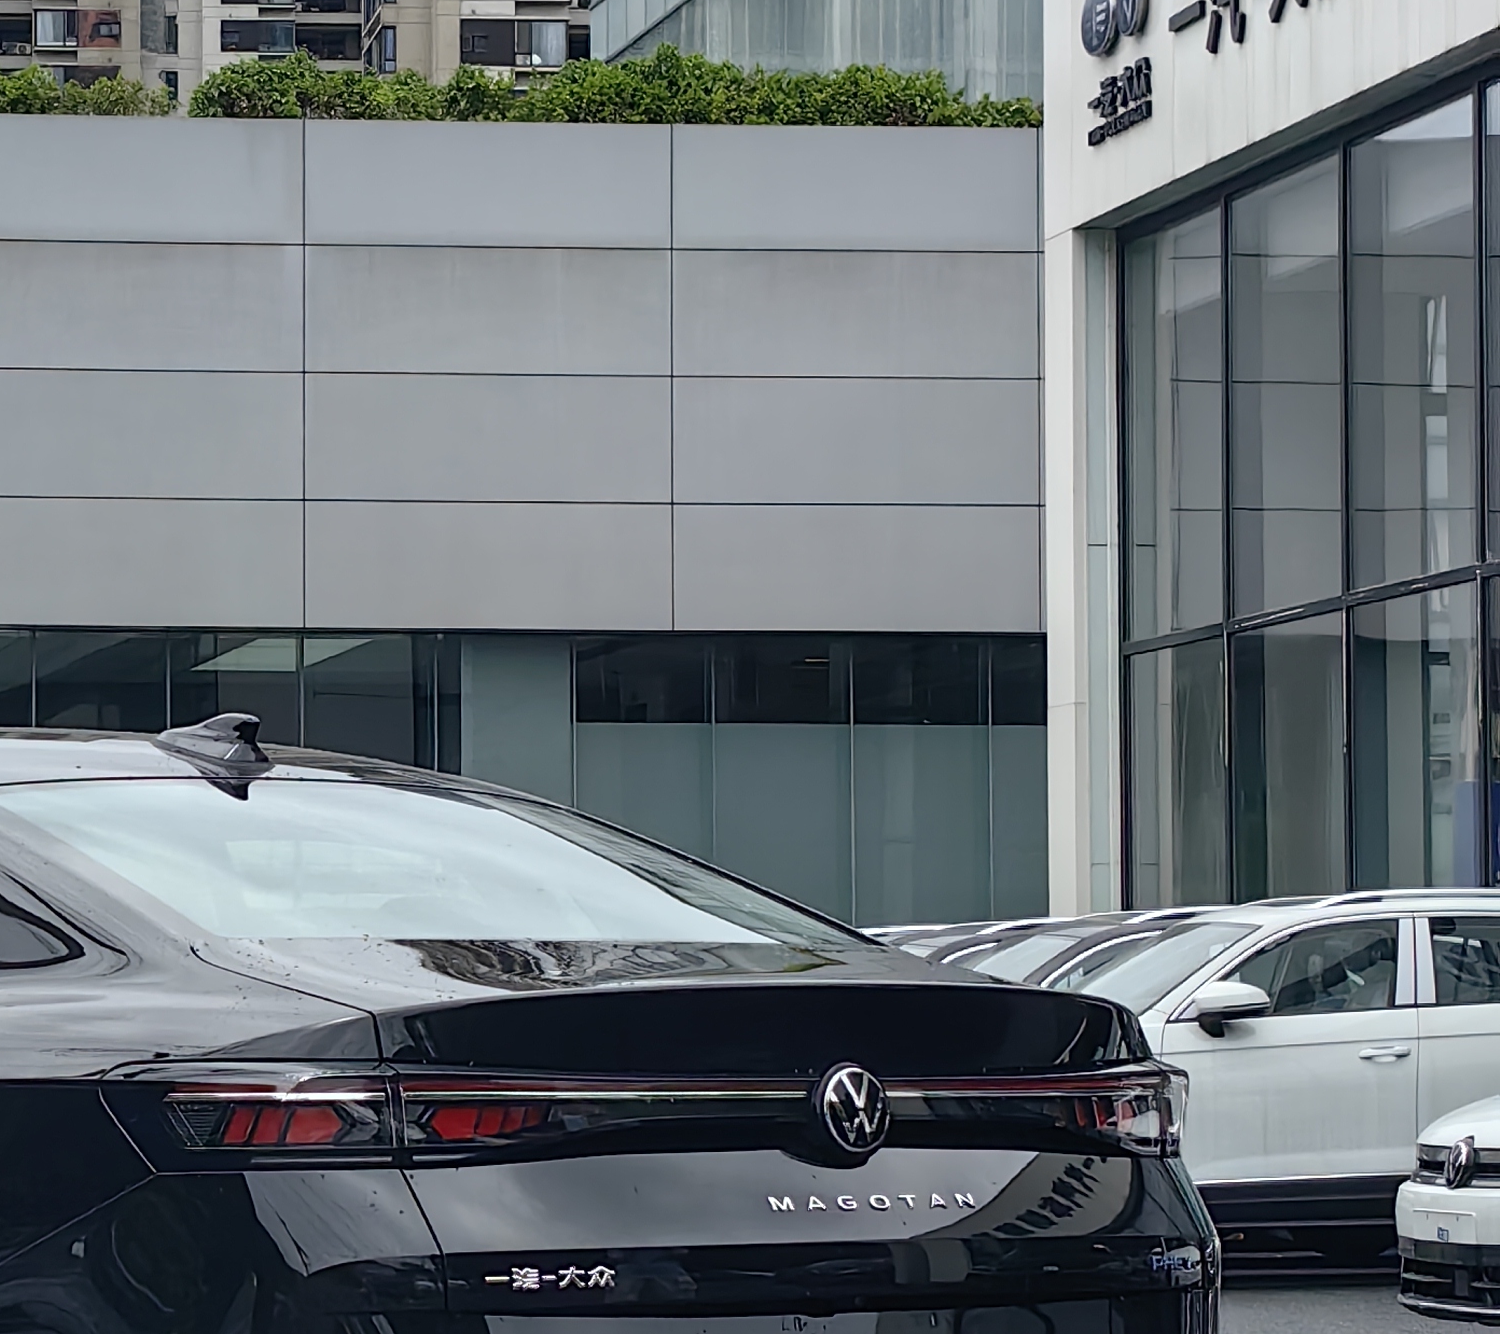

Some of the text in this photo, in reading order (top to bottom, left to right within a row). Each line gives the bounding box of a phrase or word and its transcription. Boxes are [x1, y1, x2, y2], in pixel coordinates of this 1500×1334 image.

[767, 1193, 976, 1213] MAGOTAN
[484, 1265, 616, 1291] 一汽-大众
